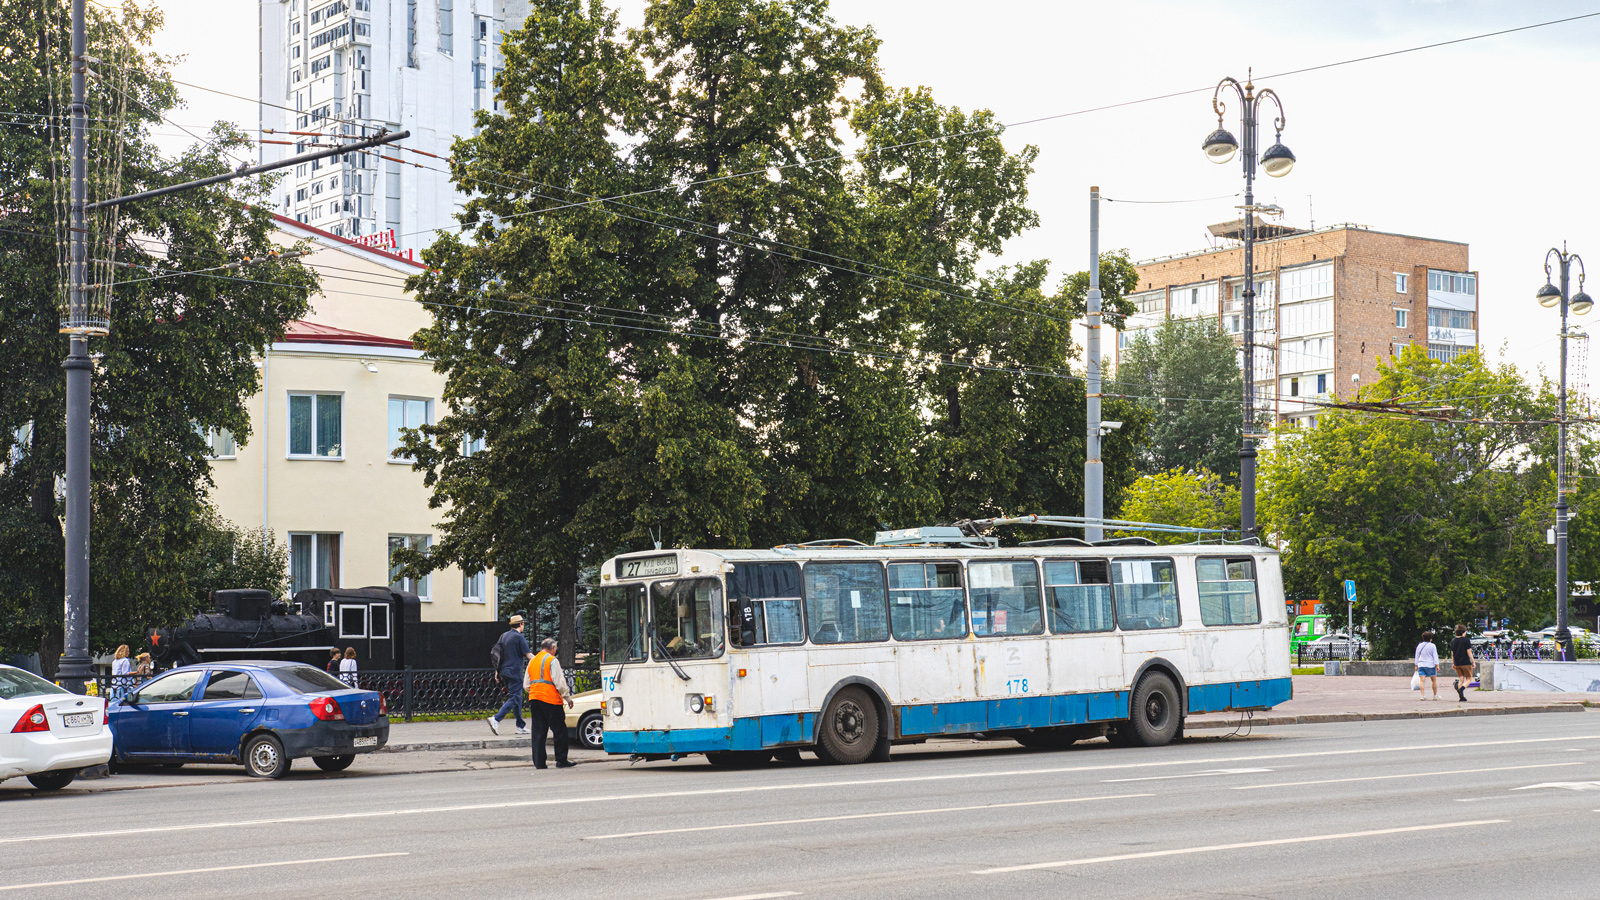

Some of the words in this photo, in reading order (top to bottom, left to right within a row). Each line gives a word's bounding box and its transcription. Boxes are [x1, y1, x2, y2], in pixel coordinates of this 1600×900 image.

[628, 562, 641, 576] 27
[744, 607, 753, 621] 178
[1006, 678, 1029, 694] 178
